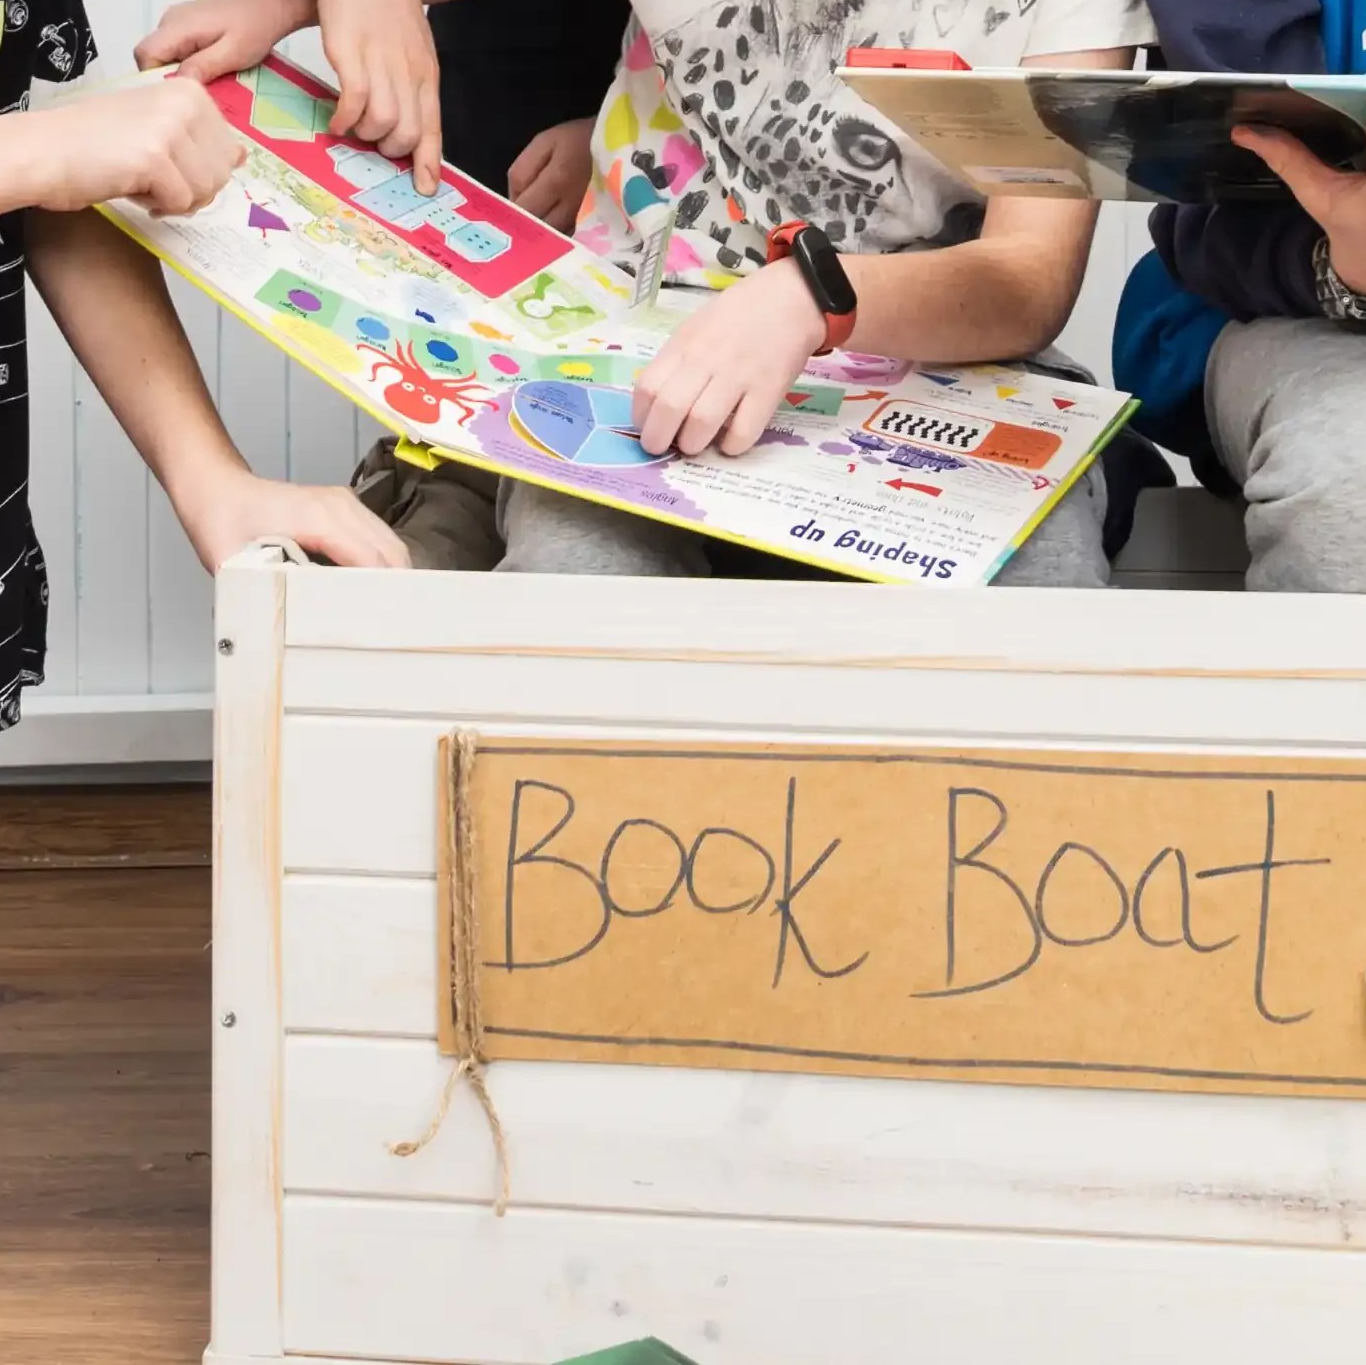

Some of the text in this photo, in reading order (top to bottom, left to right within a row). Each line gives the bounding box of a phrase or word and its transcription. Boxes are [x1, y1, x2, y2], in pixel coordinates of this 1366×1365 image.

[641, 488, 679, 506] Angles
[831, 494, 888, 515] geometry
[789, 518, 827, 544] up
[833, 527, 958, 580] Shaping
[483, 776, 1332, 1026] Book Boat
